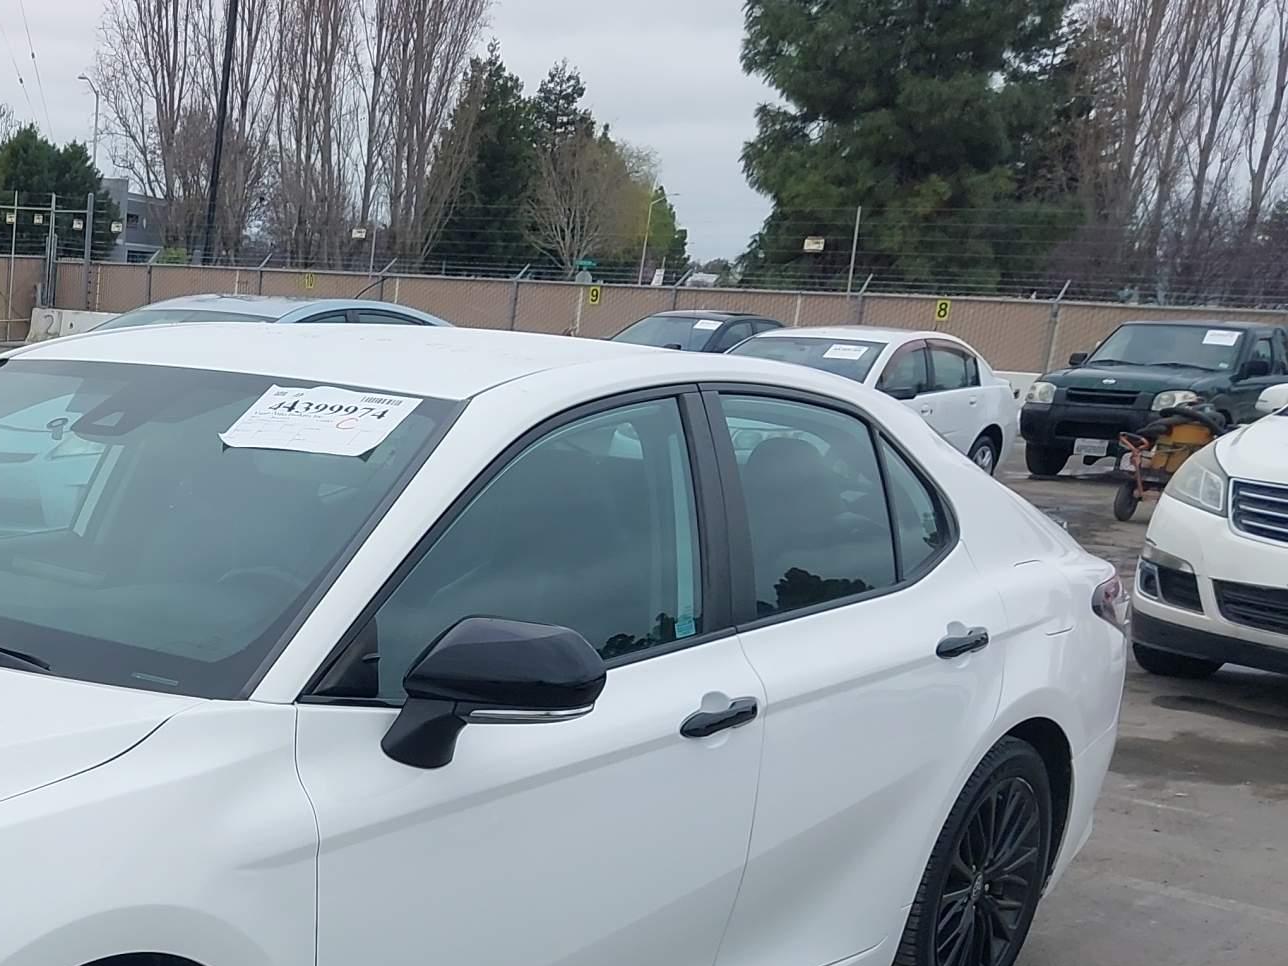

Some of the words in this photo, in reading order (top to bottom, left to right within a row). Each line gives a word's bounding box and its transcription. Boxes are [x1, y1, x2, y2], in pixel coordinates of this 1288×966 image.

[590, 288, 599, 303] 9
[937, 302, 948, 318] 8
[268, 399, 389, 421] 44399974
